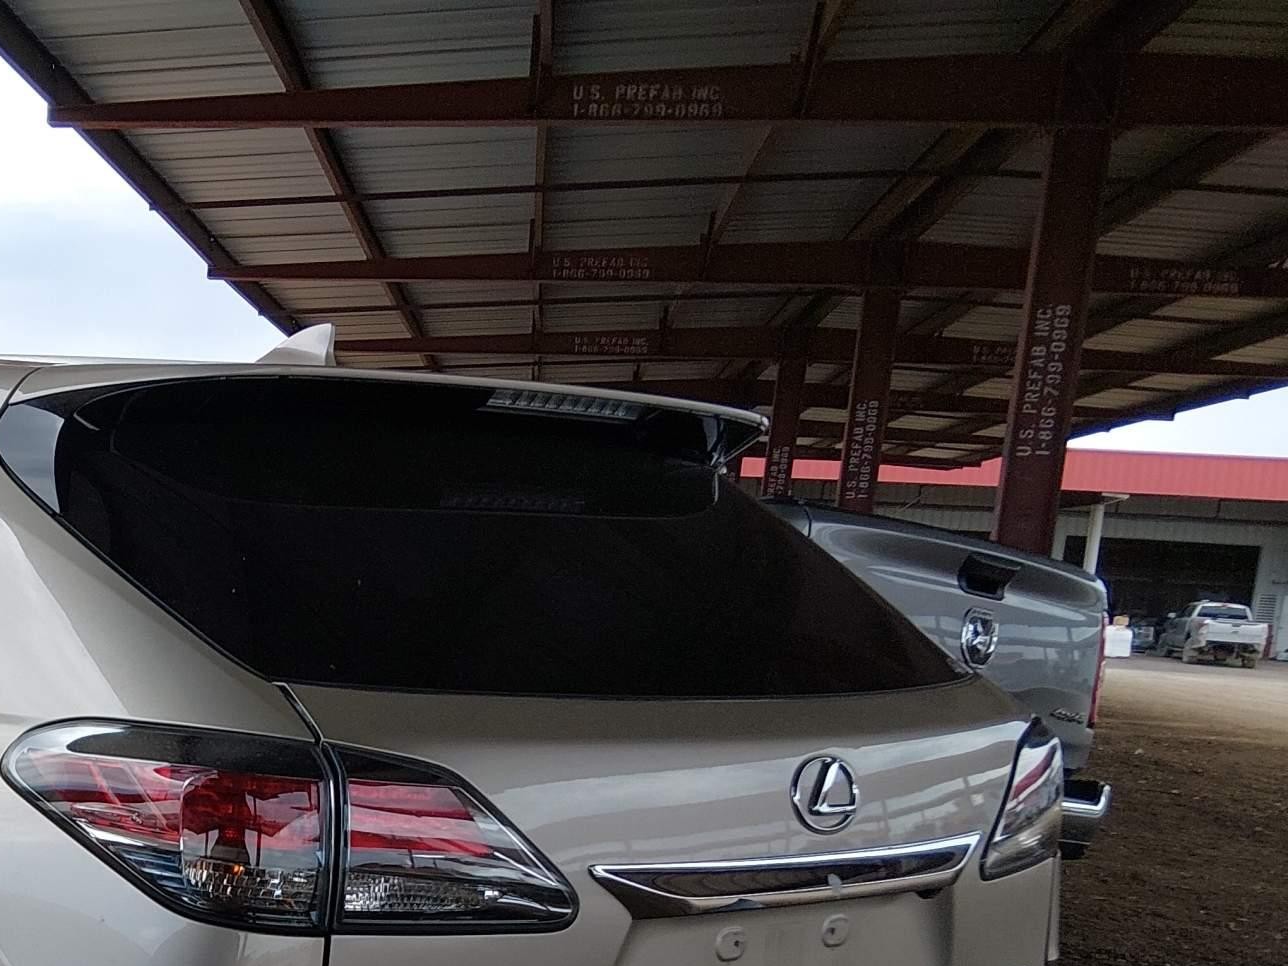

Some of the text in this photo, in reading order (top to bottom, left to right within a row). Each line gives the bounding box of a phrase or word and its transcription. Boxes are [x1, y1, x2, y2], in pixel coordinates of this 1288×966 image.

[615, 83, 683, 100] PREFAB
[1016, 303, 1053, 457] U.S. PREFAB INC.
[1035, 304, 1072, 456] 1-866-799-0969
